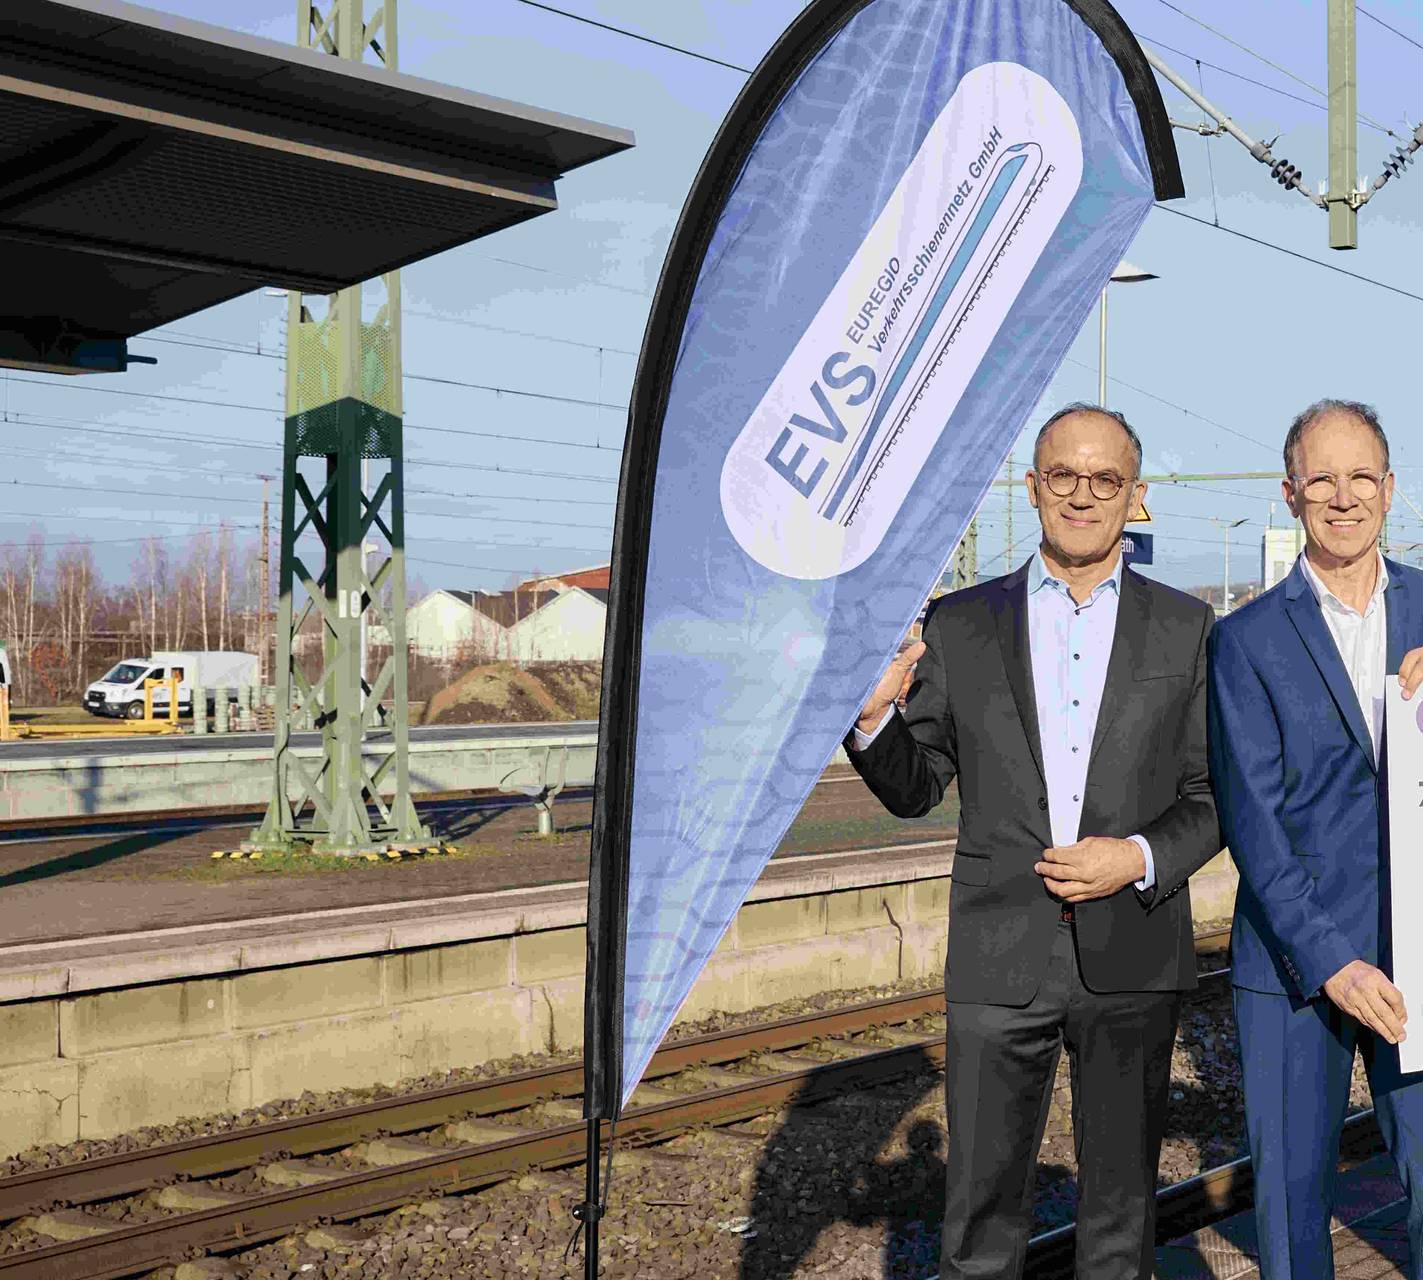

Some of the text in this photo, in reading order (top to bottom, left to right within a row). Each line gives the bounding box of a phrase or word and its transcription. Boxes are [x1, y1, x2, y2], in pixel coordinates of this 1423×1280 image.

[846, 257, 900, 345] EUREGIO
[867, 125, 1004, 354] Verkehrsschienennetz GmbH
[764, 351, 877, 499] EVS
